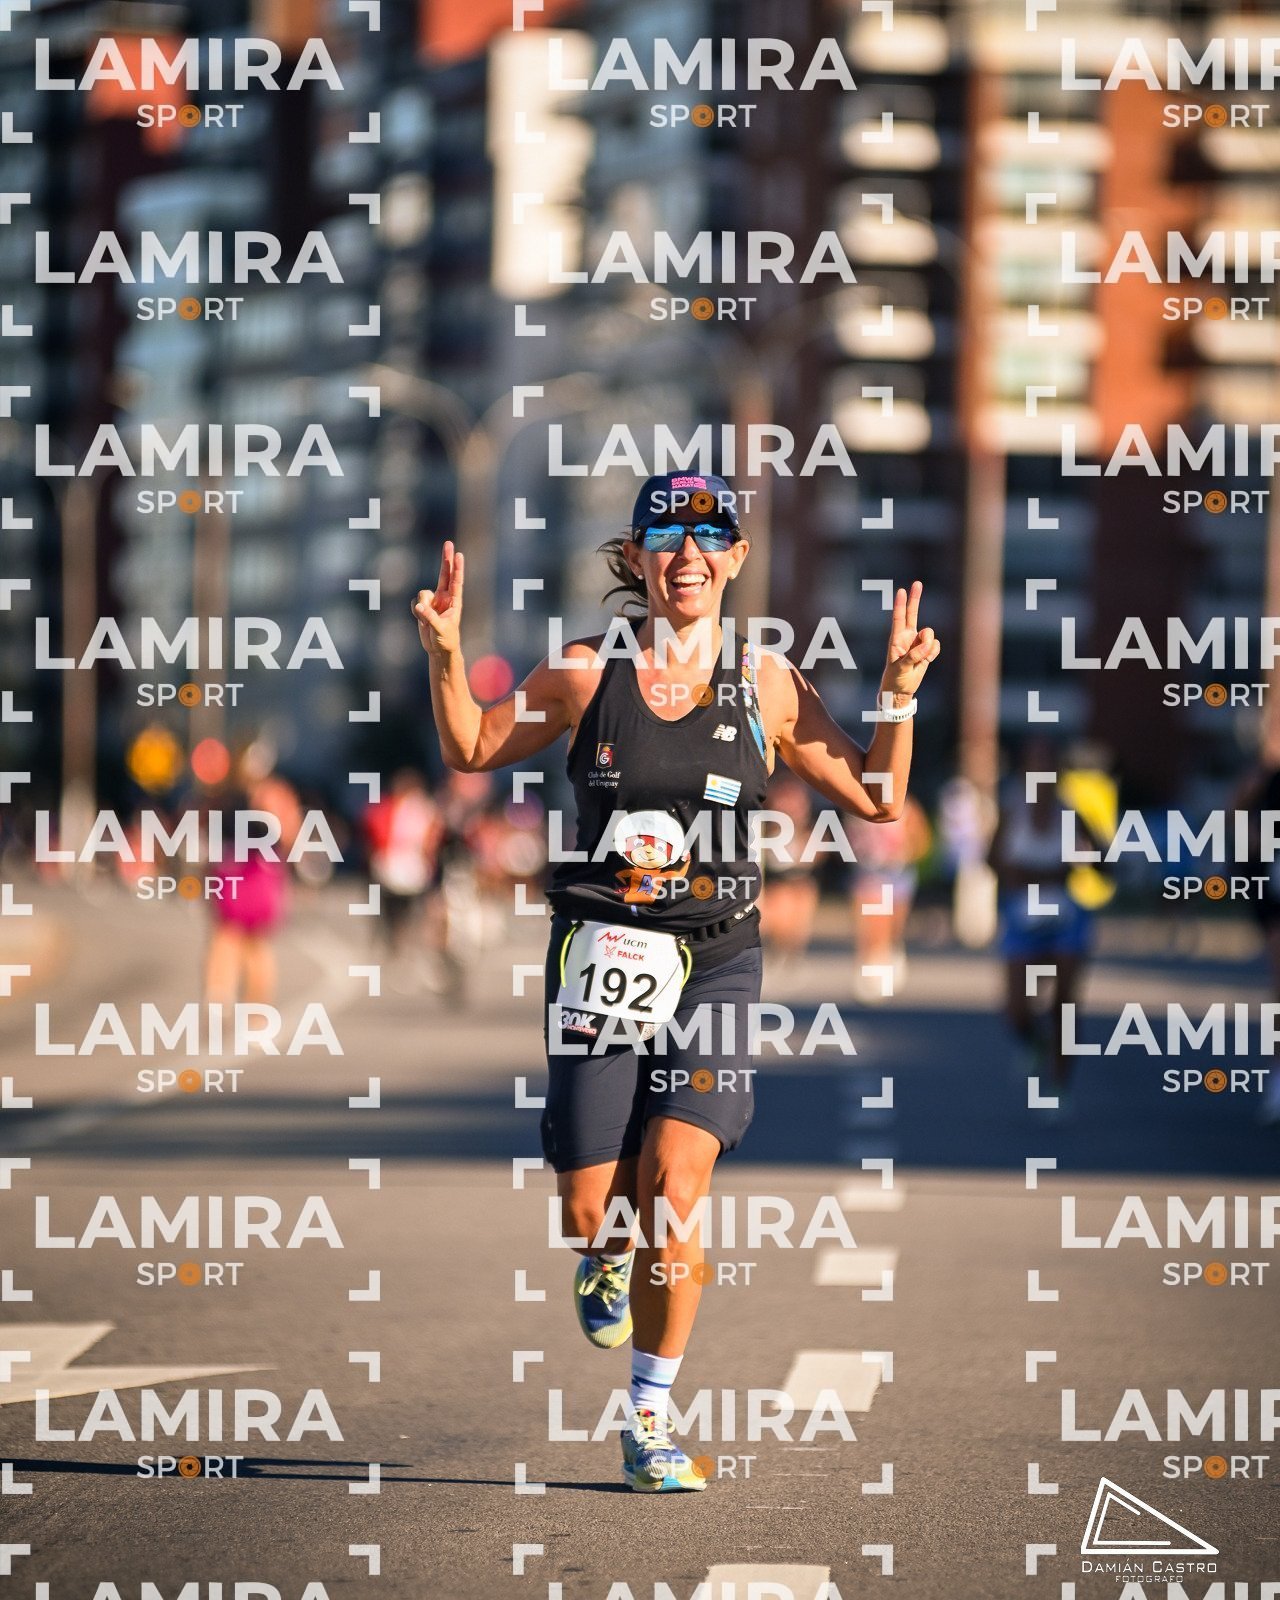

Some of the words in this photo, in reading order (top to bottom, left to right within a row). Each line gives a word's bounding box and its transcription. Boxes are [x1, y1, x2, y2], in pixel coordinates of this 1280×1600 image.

[607, 771, 621, 779] Golf
[596, 779, 619, 788] Uruguay
[623, 938, 648, 949] ucm
[617, 950, 645, 962] FALCK
[579, 963, 657, 1013] 192
[557, 1010, 596, 1030] 30K
